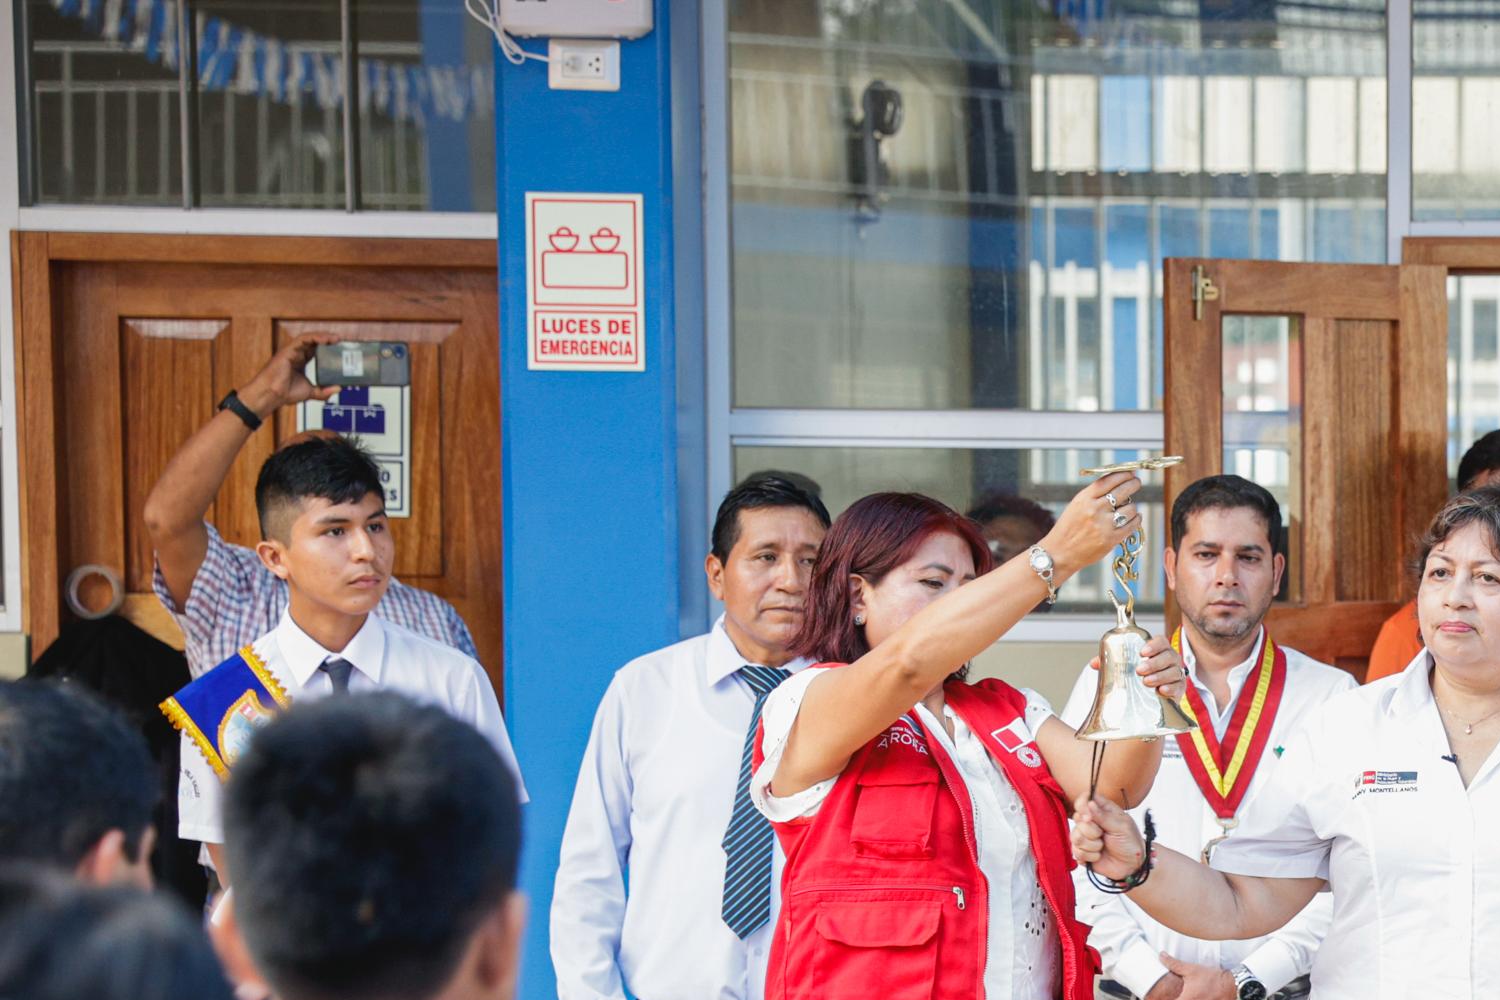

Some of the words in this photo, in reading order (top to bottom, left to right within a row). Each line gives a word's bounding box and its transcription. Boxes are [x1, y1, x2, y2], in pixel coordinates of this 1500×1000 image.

[541, 319, 602, 335] LUCES
[607, 319, 632, 335] DE
[540, 340, 634, 356] EMERGENCIA
